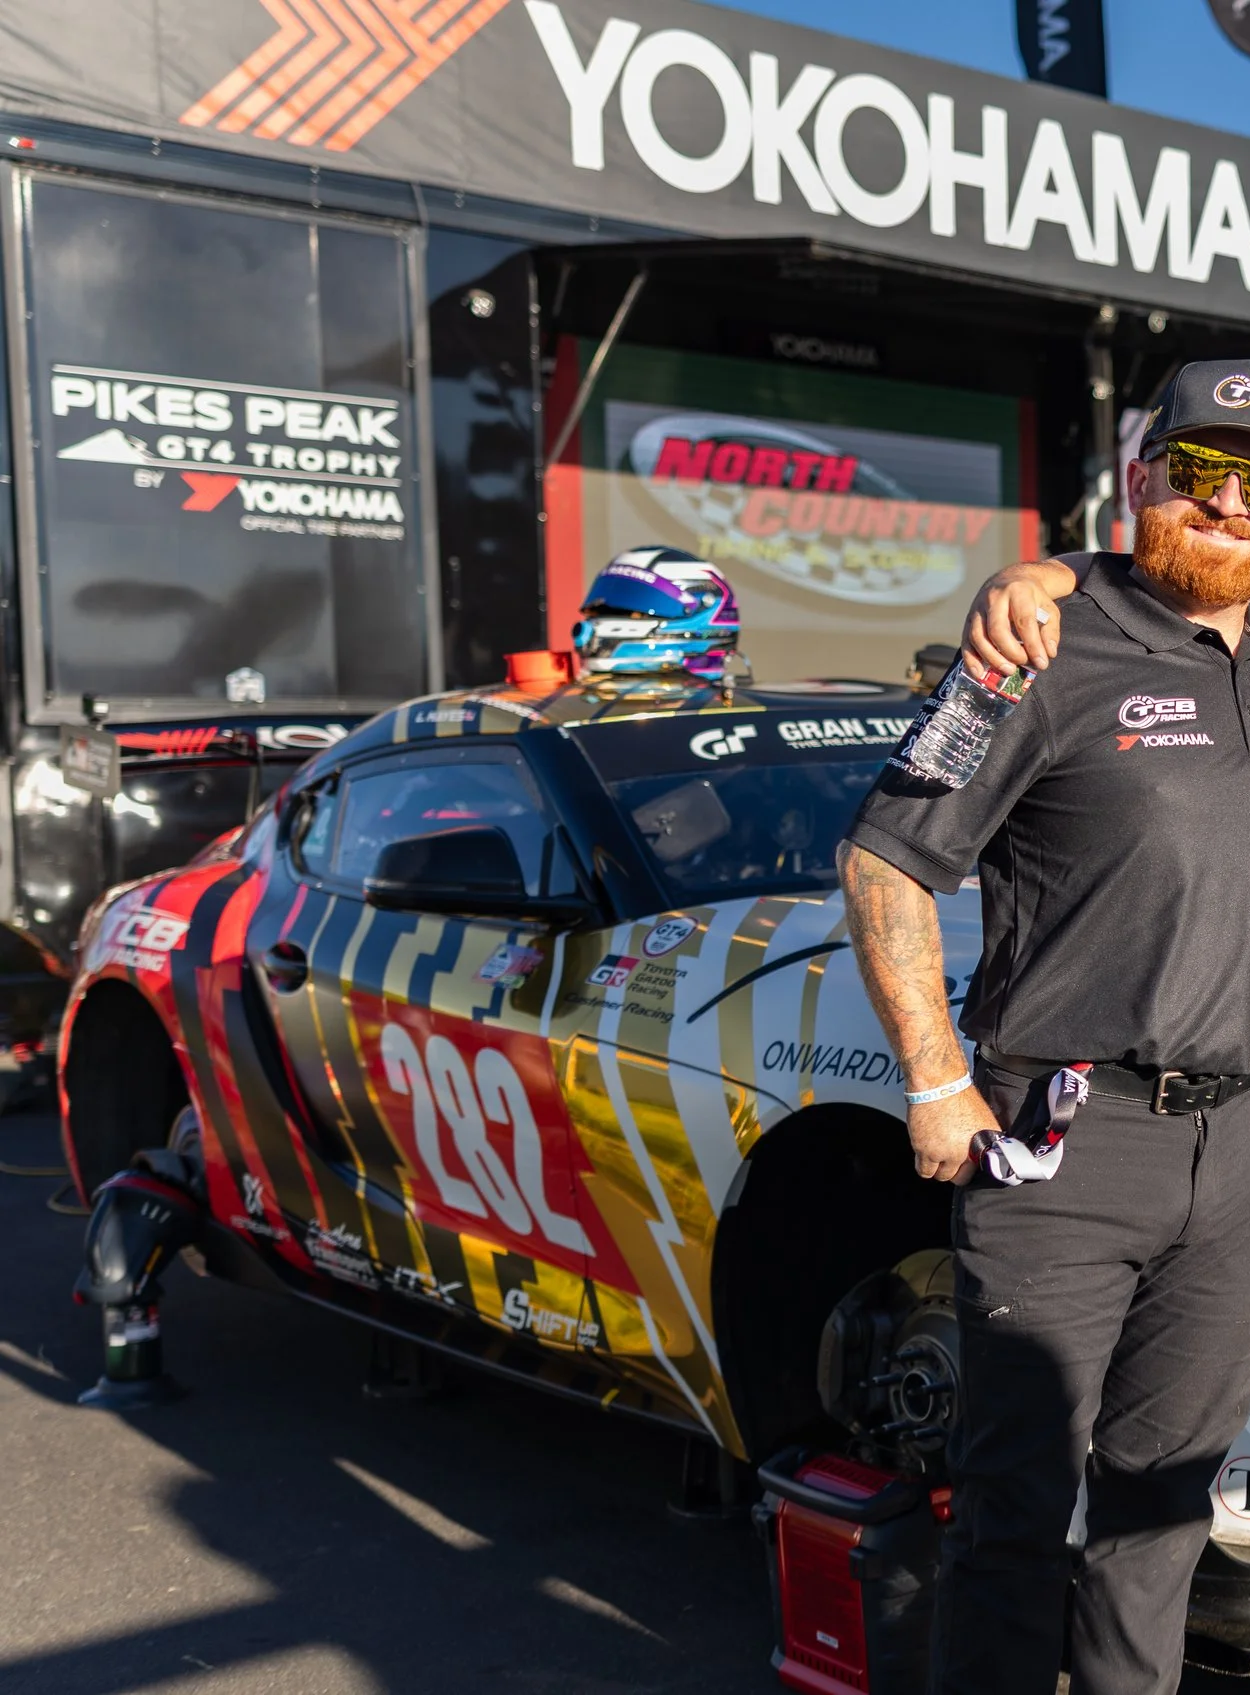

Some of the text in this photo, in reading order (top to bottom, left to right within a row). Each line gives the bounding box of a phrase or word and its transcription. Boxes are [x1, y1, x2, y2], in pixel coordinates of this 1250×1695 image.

[51, 375, 400, 449] PIKES PEAK
[157, 434, 401, 478] GT4 TROPHY
[652, 436, 859, 493] NORTH
[132, 469, 404, 522] BY YOKOHAMA
[740, 487, 994, 546] COUNTRY
[1133, 700, 1197, 717] TCB
[1160, 713, 1197, 722] RACING
[777, 718, 866, 741] GRAN
[1139, 733, 1212, 747] YOKOHAMA
[787, 740, 822, 749] THE
[655, 922, 689, 940] GT4
[634, 973, 676, 988] GAZOO
[643, 962, 688, 979] TOYOTA
[628, 983, 669, 999] Racing
[624, 1000, 675, 1024] Racing
[380, 1022, 597, 1258] 282
[501, 1287, 579, 1342] SHIFT
